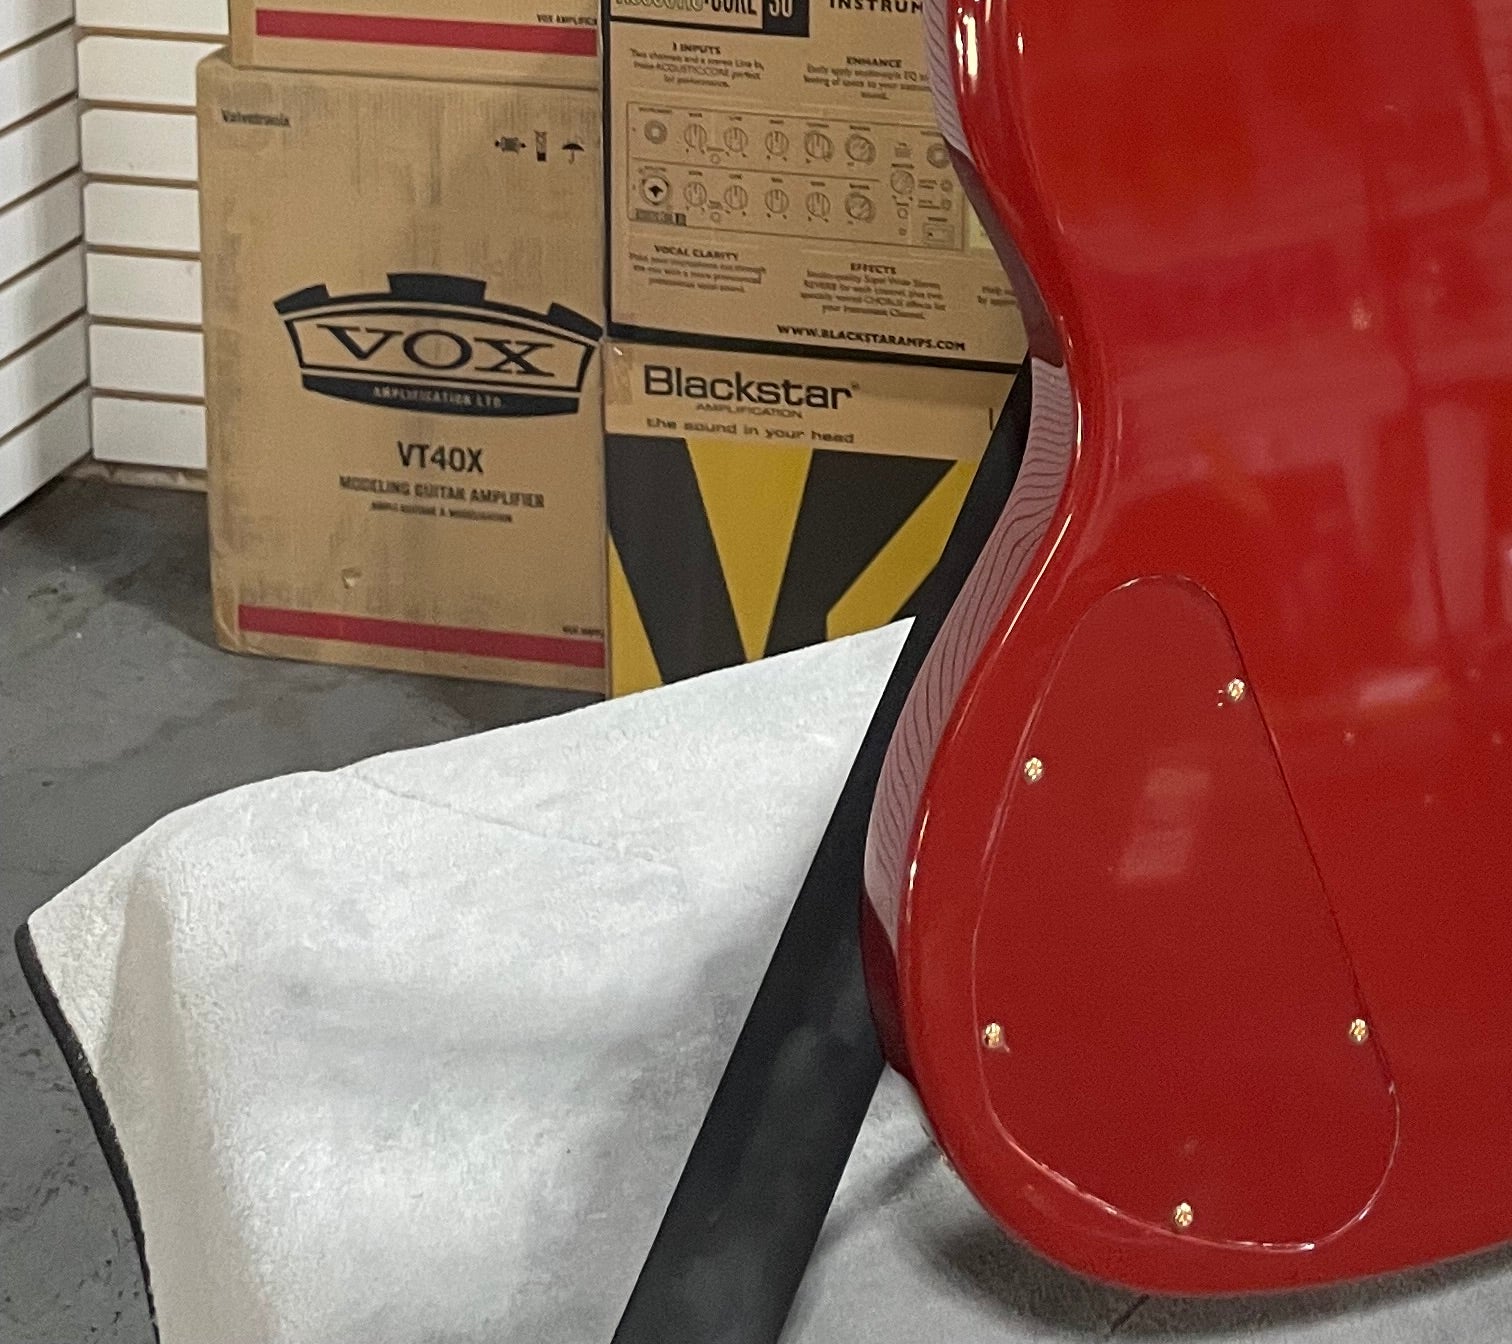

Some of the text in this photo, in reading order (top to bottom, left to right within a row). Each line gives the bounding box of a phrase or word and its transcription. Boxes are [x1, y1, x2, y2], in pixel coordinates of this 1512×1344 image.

[654, 244, 739, 261] VOCAL CLARITY
[315, 323, 555, 378] VOX
[776, 323, 967, 352] WWW.BLACKSTARAMPS.COM
[643, 363, 854, 411] Blackstar
[695, 401, 804, 419] AMPLIFICATION
[646, 417, 855, 445] the sound in your head
[397, 440, 485, 474] VT40X
[339, 474, 412, 497] MODELING
